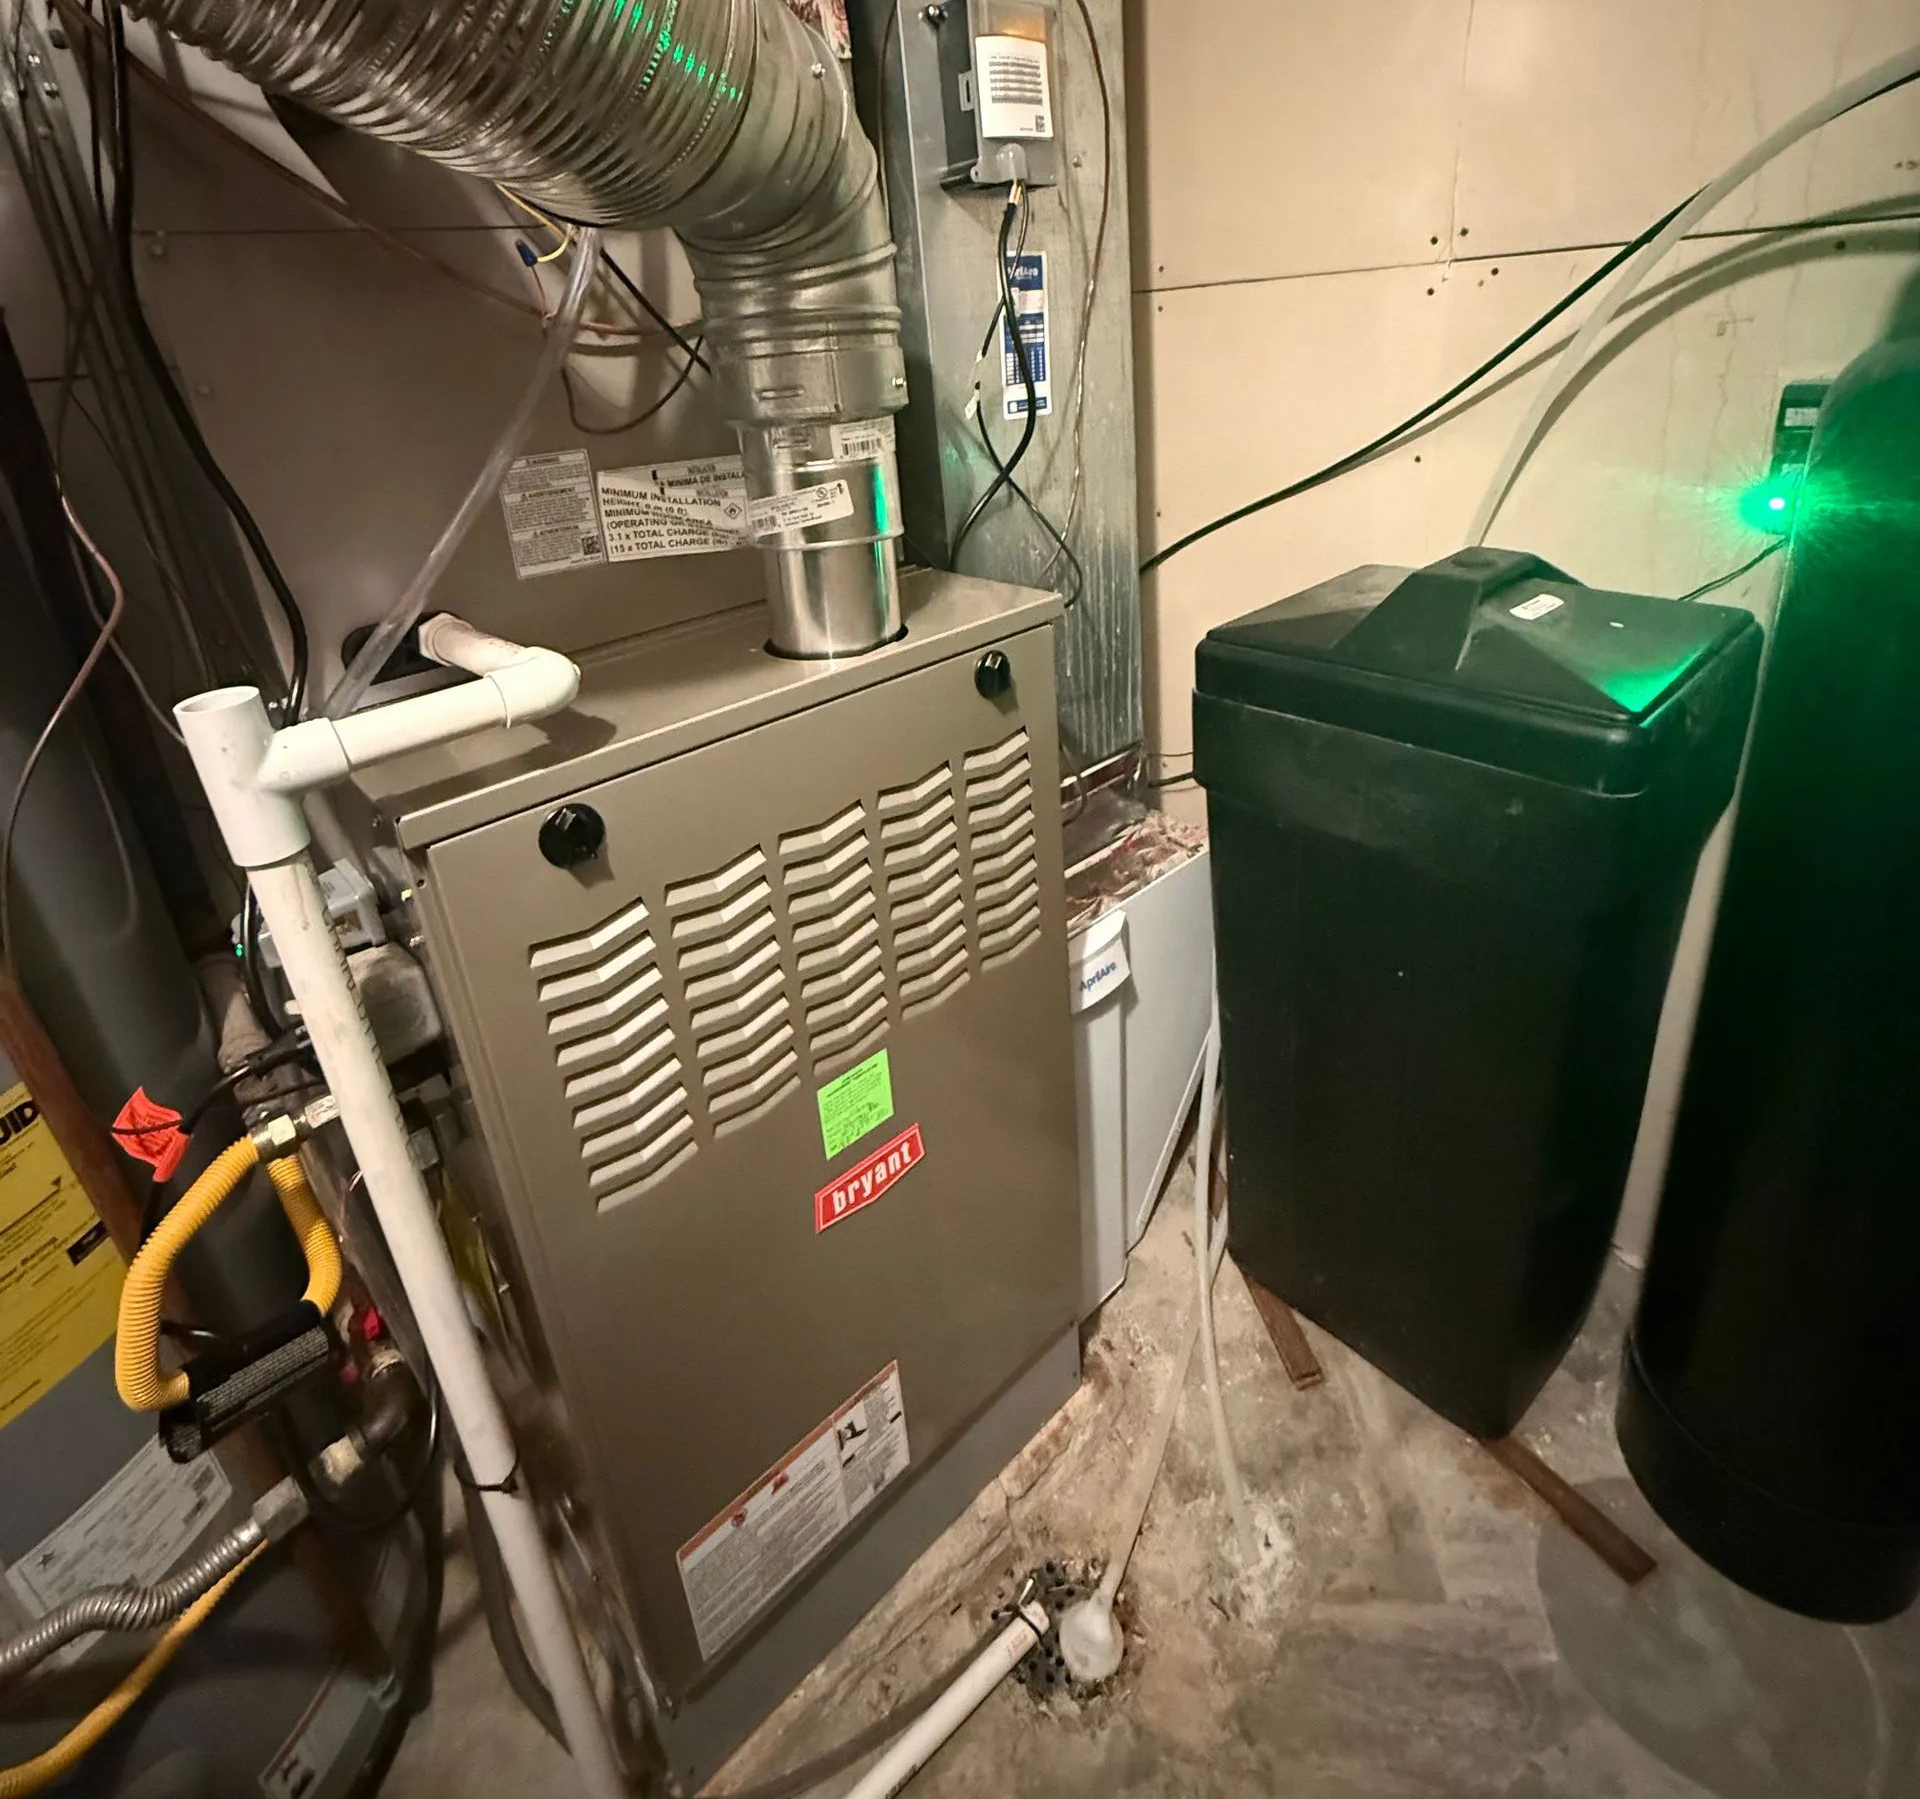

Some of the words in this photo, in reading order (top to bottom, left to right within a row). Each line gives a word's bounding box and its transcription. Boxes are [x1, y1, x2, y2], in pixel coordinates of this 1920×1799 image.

[700, 474, 711, 484] DE
[601, 487, 647, 499] MINIMUM
[651, 492, 721, 506] INSTALLATION
[604, 508, 649, 517] MINIMUM
[606, 518, 668, 531] (OPERATING
[633, 529, 664, 539] TOTAL
[667, 527, 708, 537] CHARGE
[635, 541, 666, 551] TOTAL
[668, 538, 709, 548] CHARGE
[831, 1141, 913, 1215] bryant
